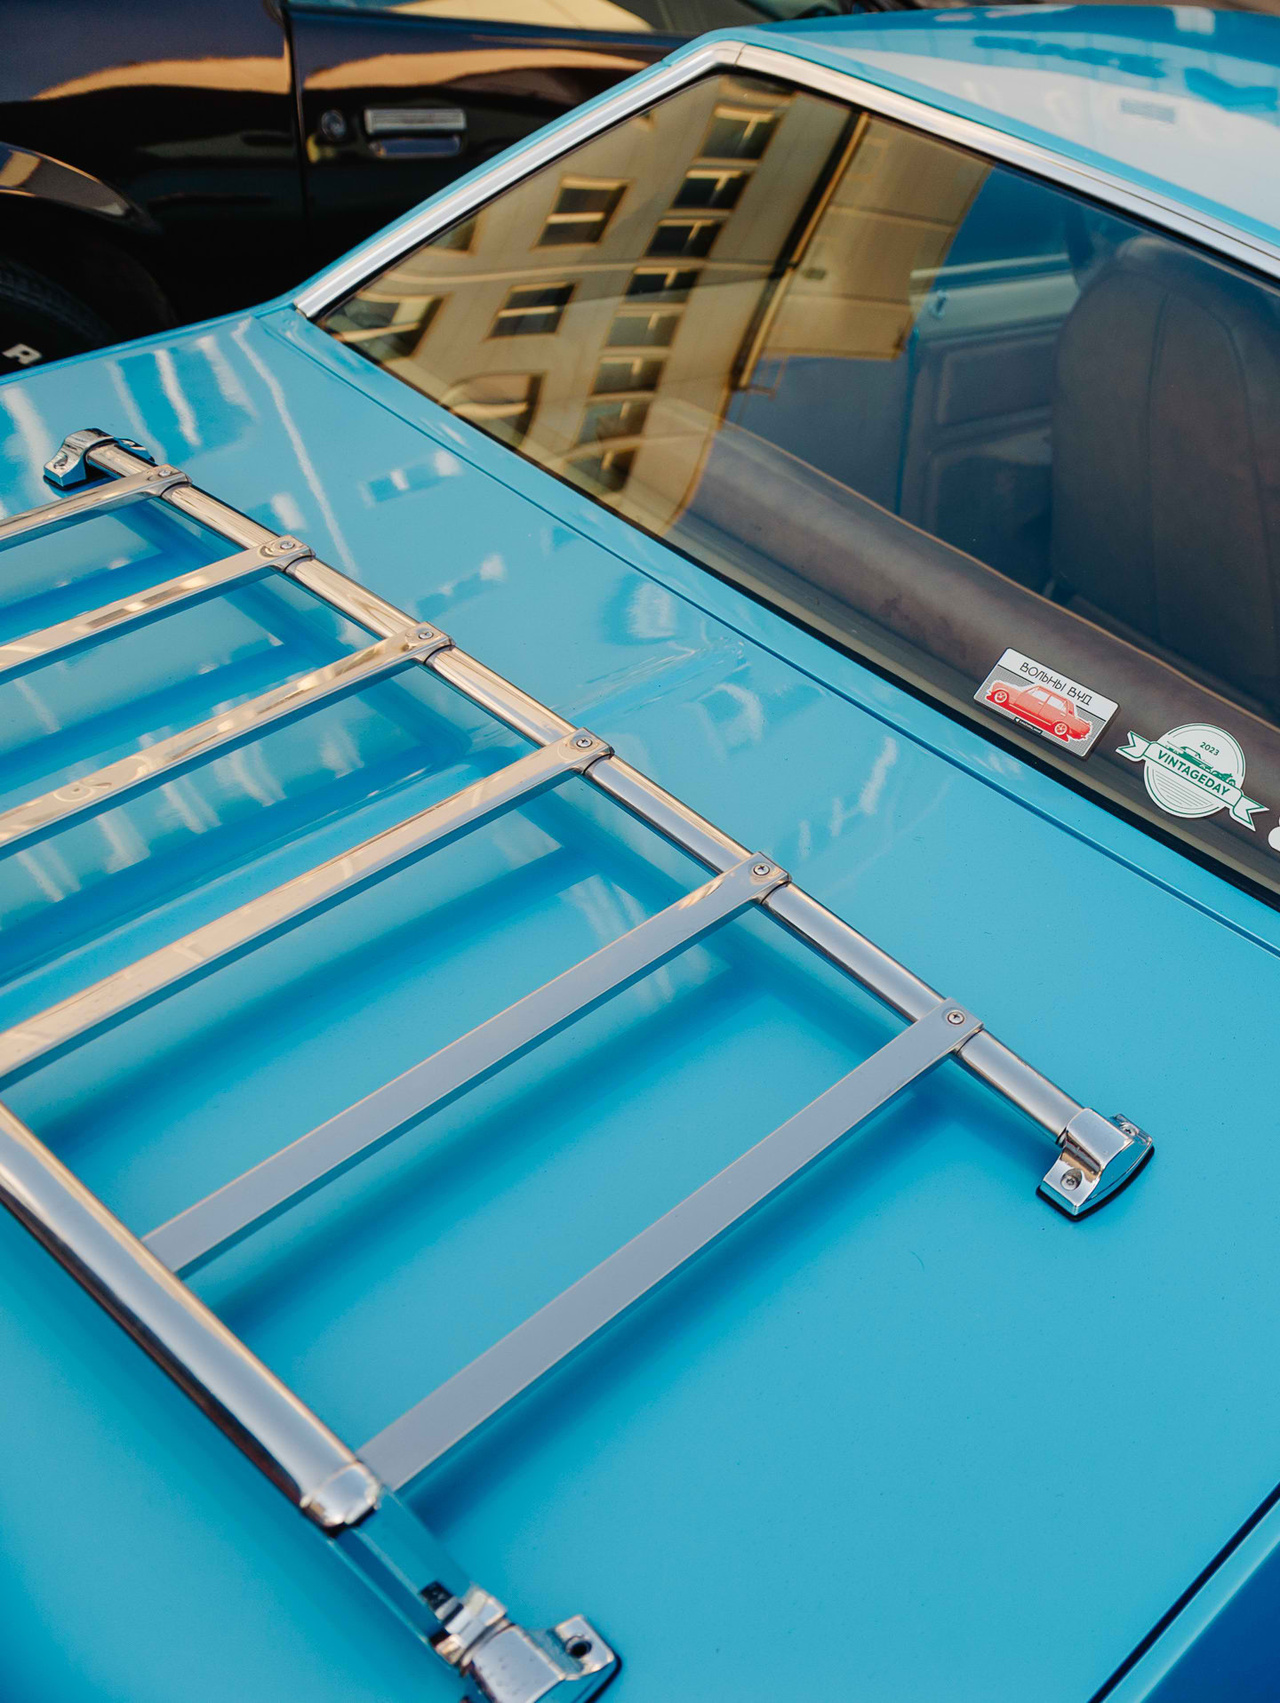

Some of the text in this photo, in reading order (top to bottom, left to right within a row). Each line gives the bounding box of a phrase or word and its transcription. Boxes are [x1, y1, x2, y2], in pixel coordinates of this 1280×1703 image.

[1019, 662, 1066, 692] ВОЛЬНЫ
[1199, 741, 1220, 756] 2023
[1158, 750, 1230, 796] VINTAGEDAY
